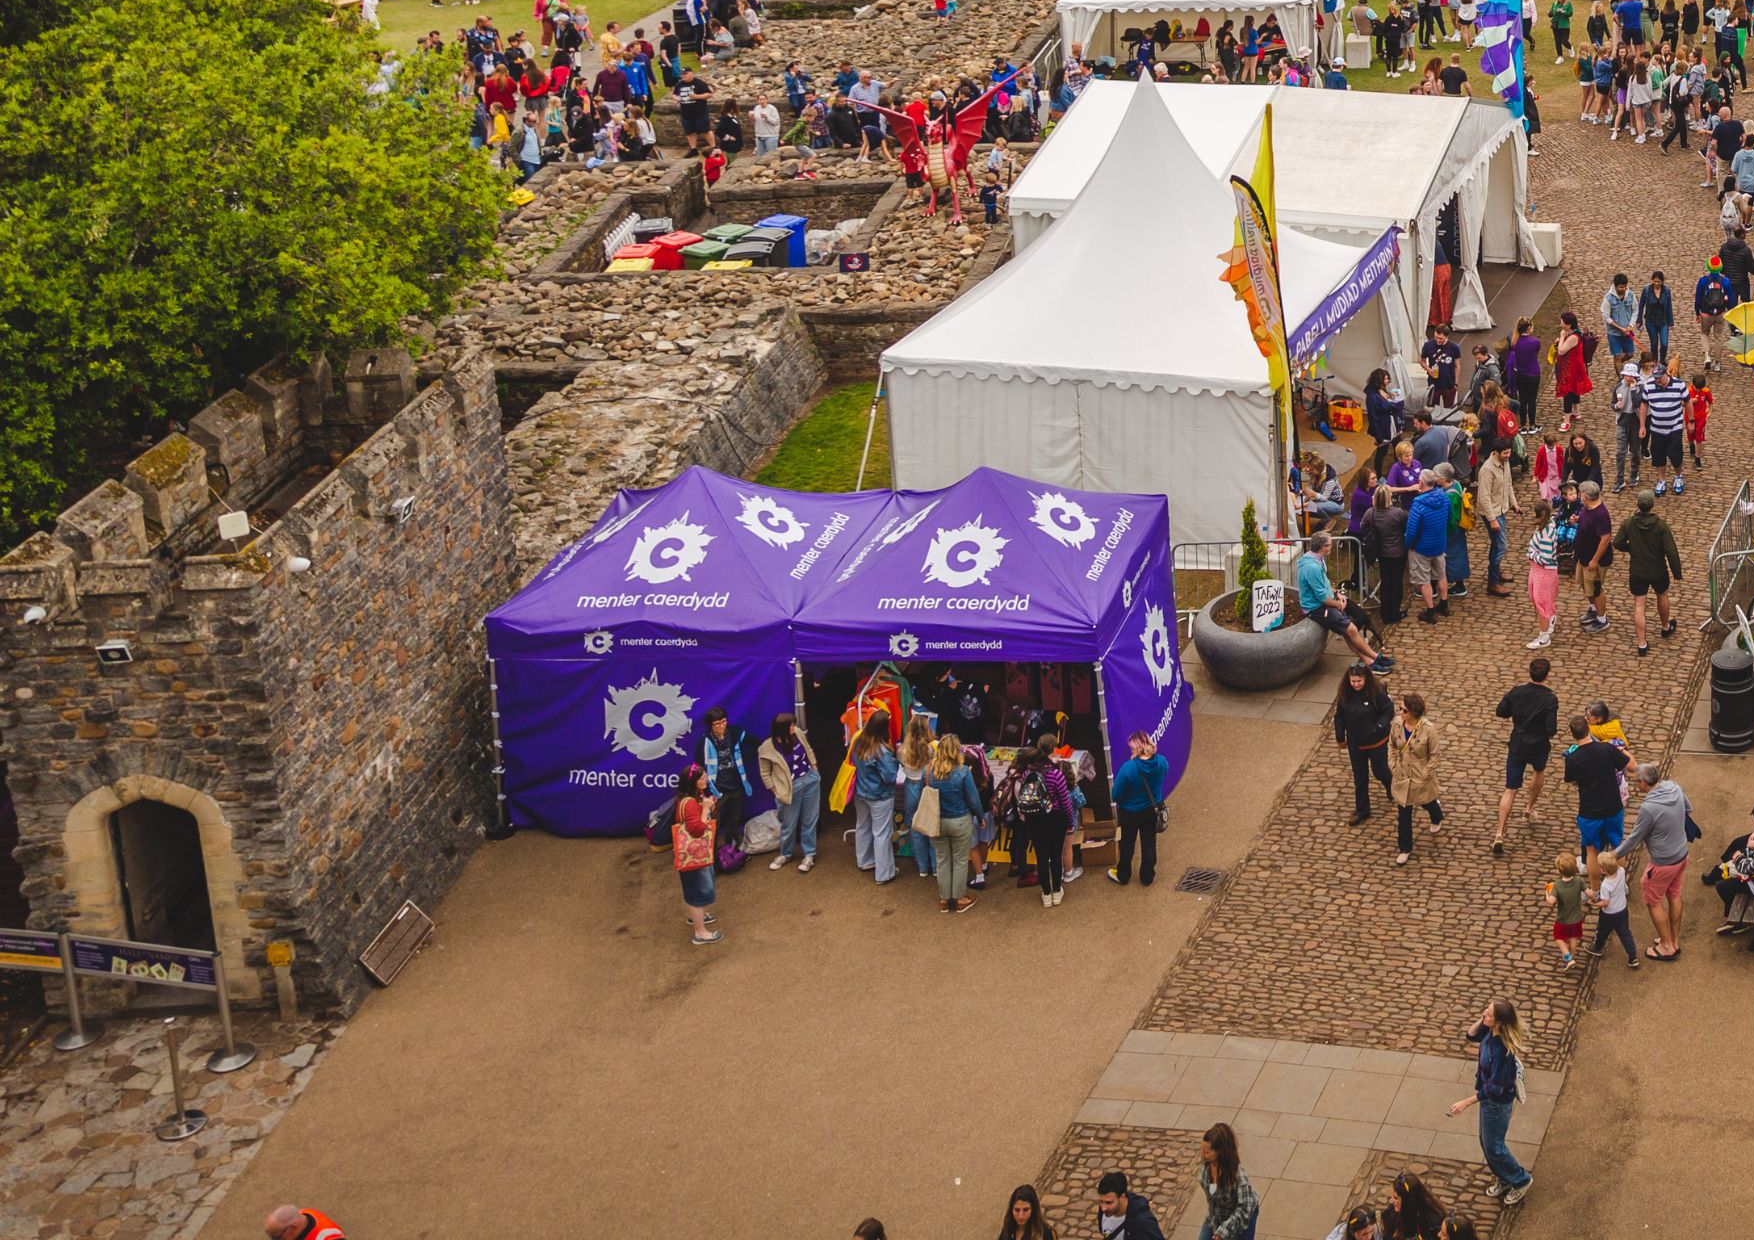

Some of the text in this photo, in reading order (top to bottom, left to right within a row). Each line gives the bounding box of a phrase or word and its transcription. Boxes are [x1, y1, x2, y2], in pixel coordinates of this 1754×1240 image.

[1296, 242, 1395, 357] PABELL MUDIAD MEITHRIN
[789, 512, 850, 580] menter caerdydd
[1085, 507, 1135, 582] menter caerdydd
[576, 591, 730, 611] menter caerdydd
[877, 594, 1031, 614] menter caerdydd
[1255, 601, 1281, 618] 2022
[620, 637, 653, 647] menter
[655, 637, 698, 648] caerdydd
[925, 640, 958, 650] menter
[959, 640, 1003, 651] caerdydd
[569, 769, 637, 788] menter
